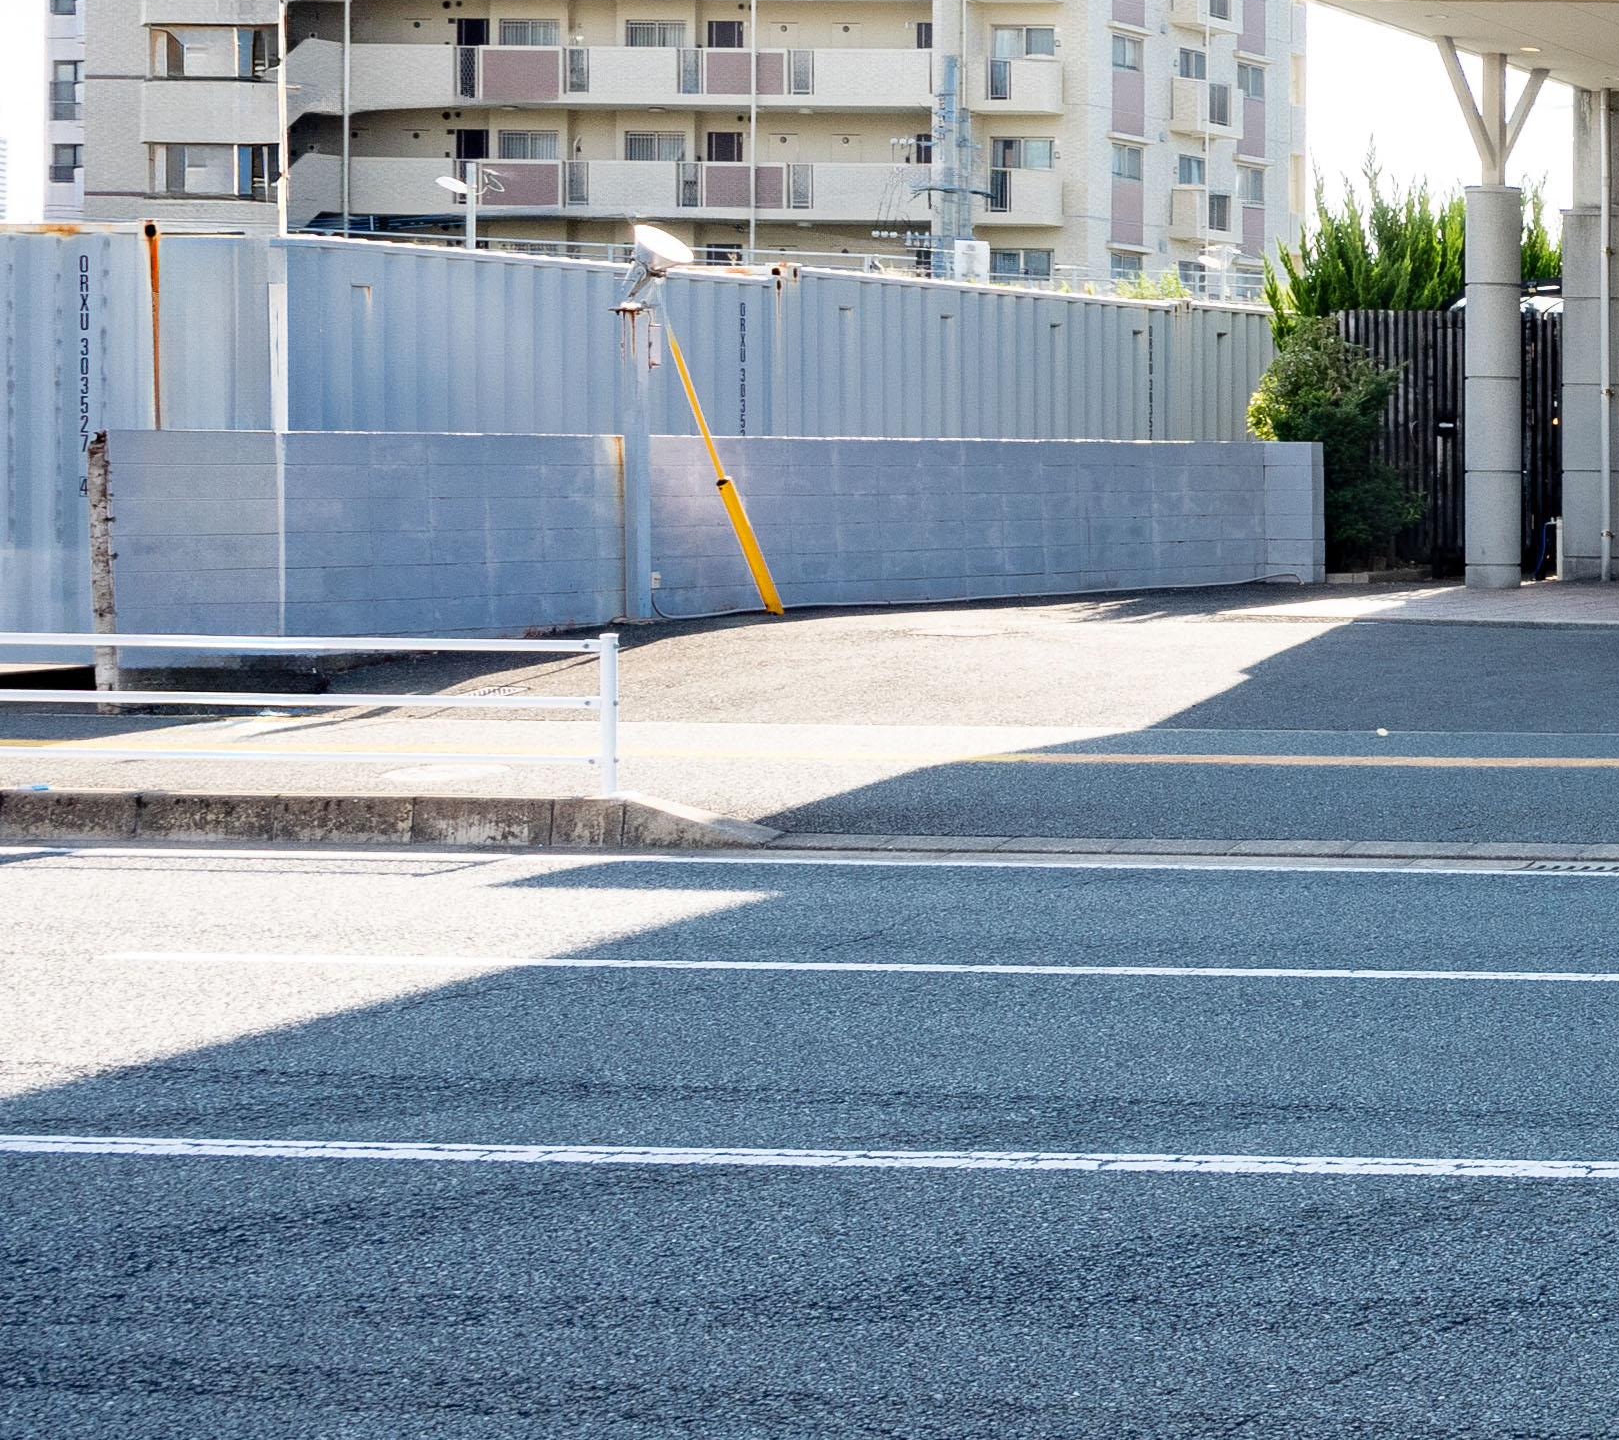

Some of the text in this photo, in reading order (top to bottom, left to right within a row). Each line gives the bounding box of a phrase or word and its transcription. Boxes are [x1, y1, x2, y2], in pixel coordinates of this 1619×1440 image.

[79, 255, 89, 331] ORXU
[739, 302, 747, 363] ORXU
[79, 338, 89, 453] 303527
